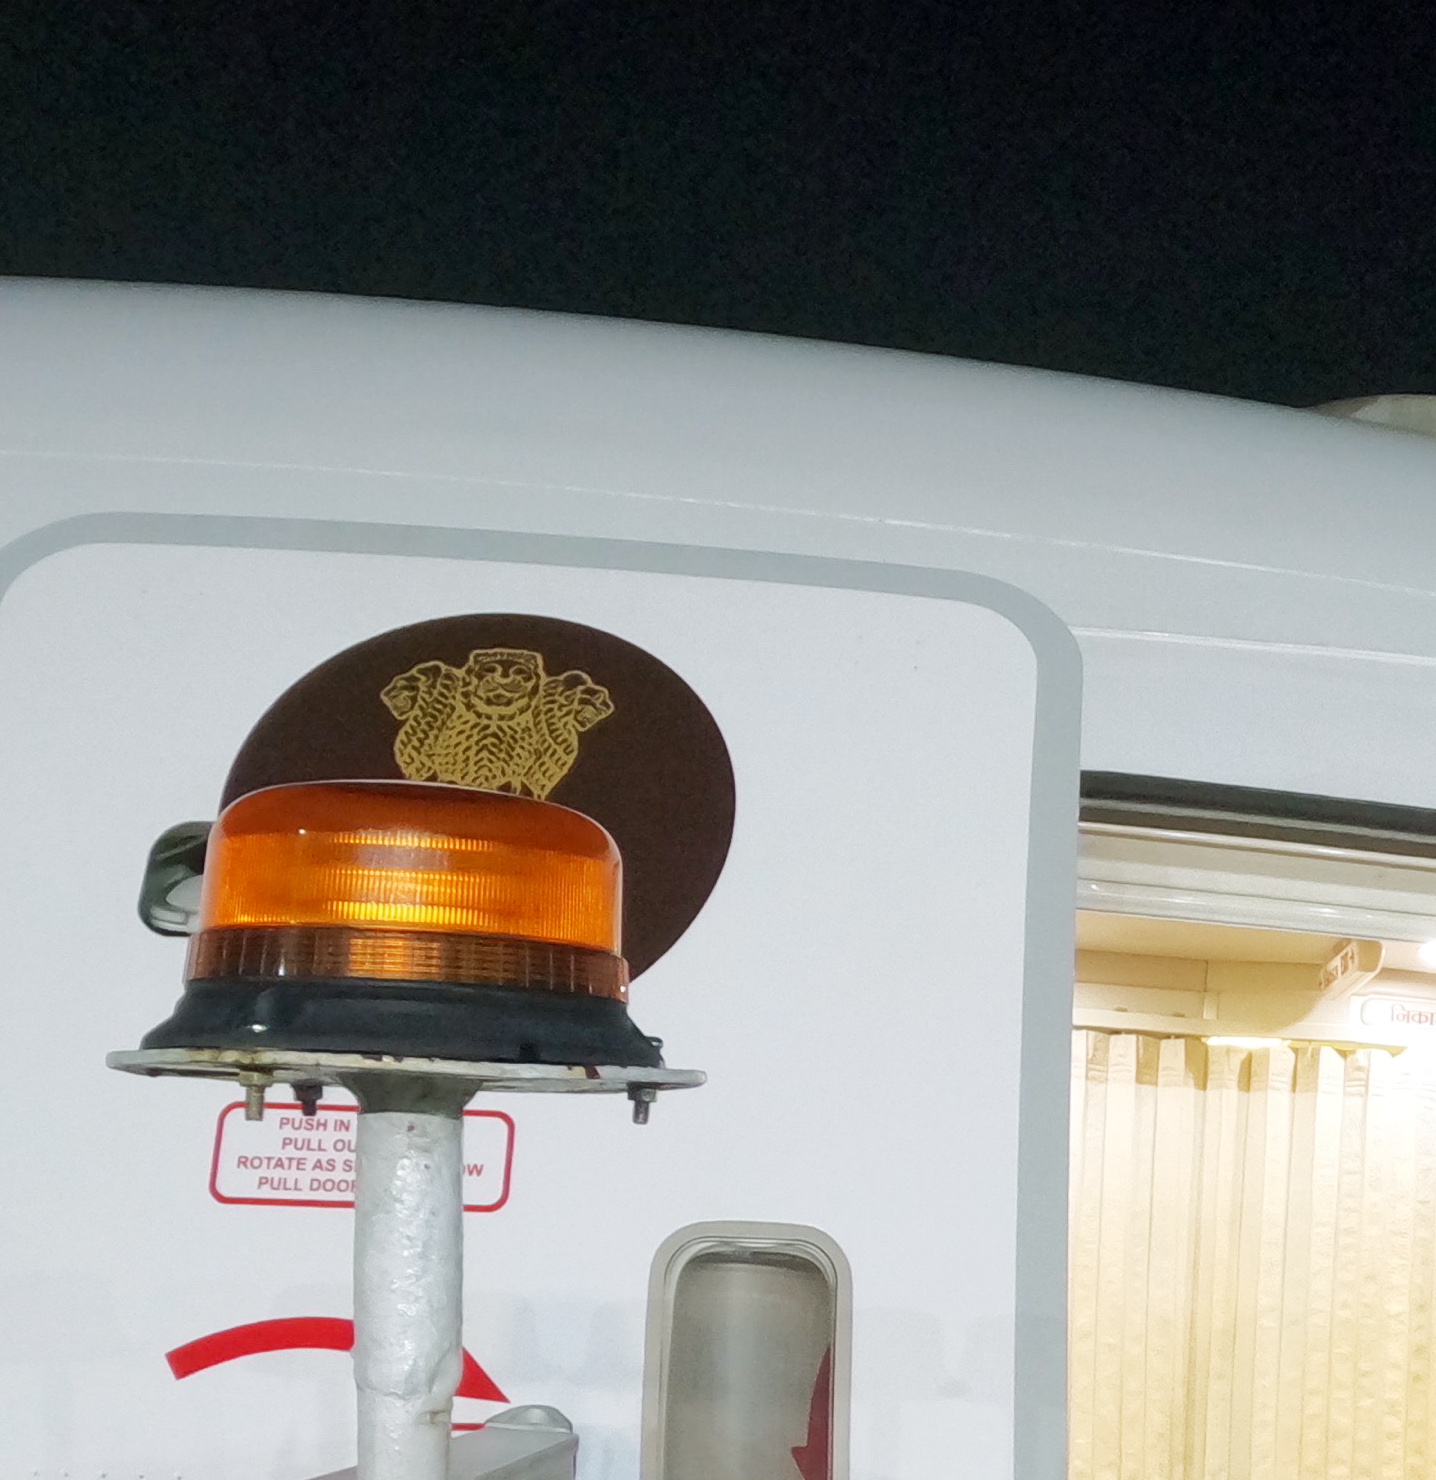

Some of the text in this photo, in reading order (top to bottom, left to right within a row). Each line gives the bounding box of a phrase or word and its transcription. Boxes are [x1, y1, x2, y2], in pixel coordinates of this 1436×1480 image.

[279, 1117, 351, 1132] PUSH IN
[281, 1137, 357, 1152] PULL OU
[236, 1156, 307, 1170] ROTATE
[311, 1157, 336, 1172] AS
[257, 1176, 305, 1190] PULL
